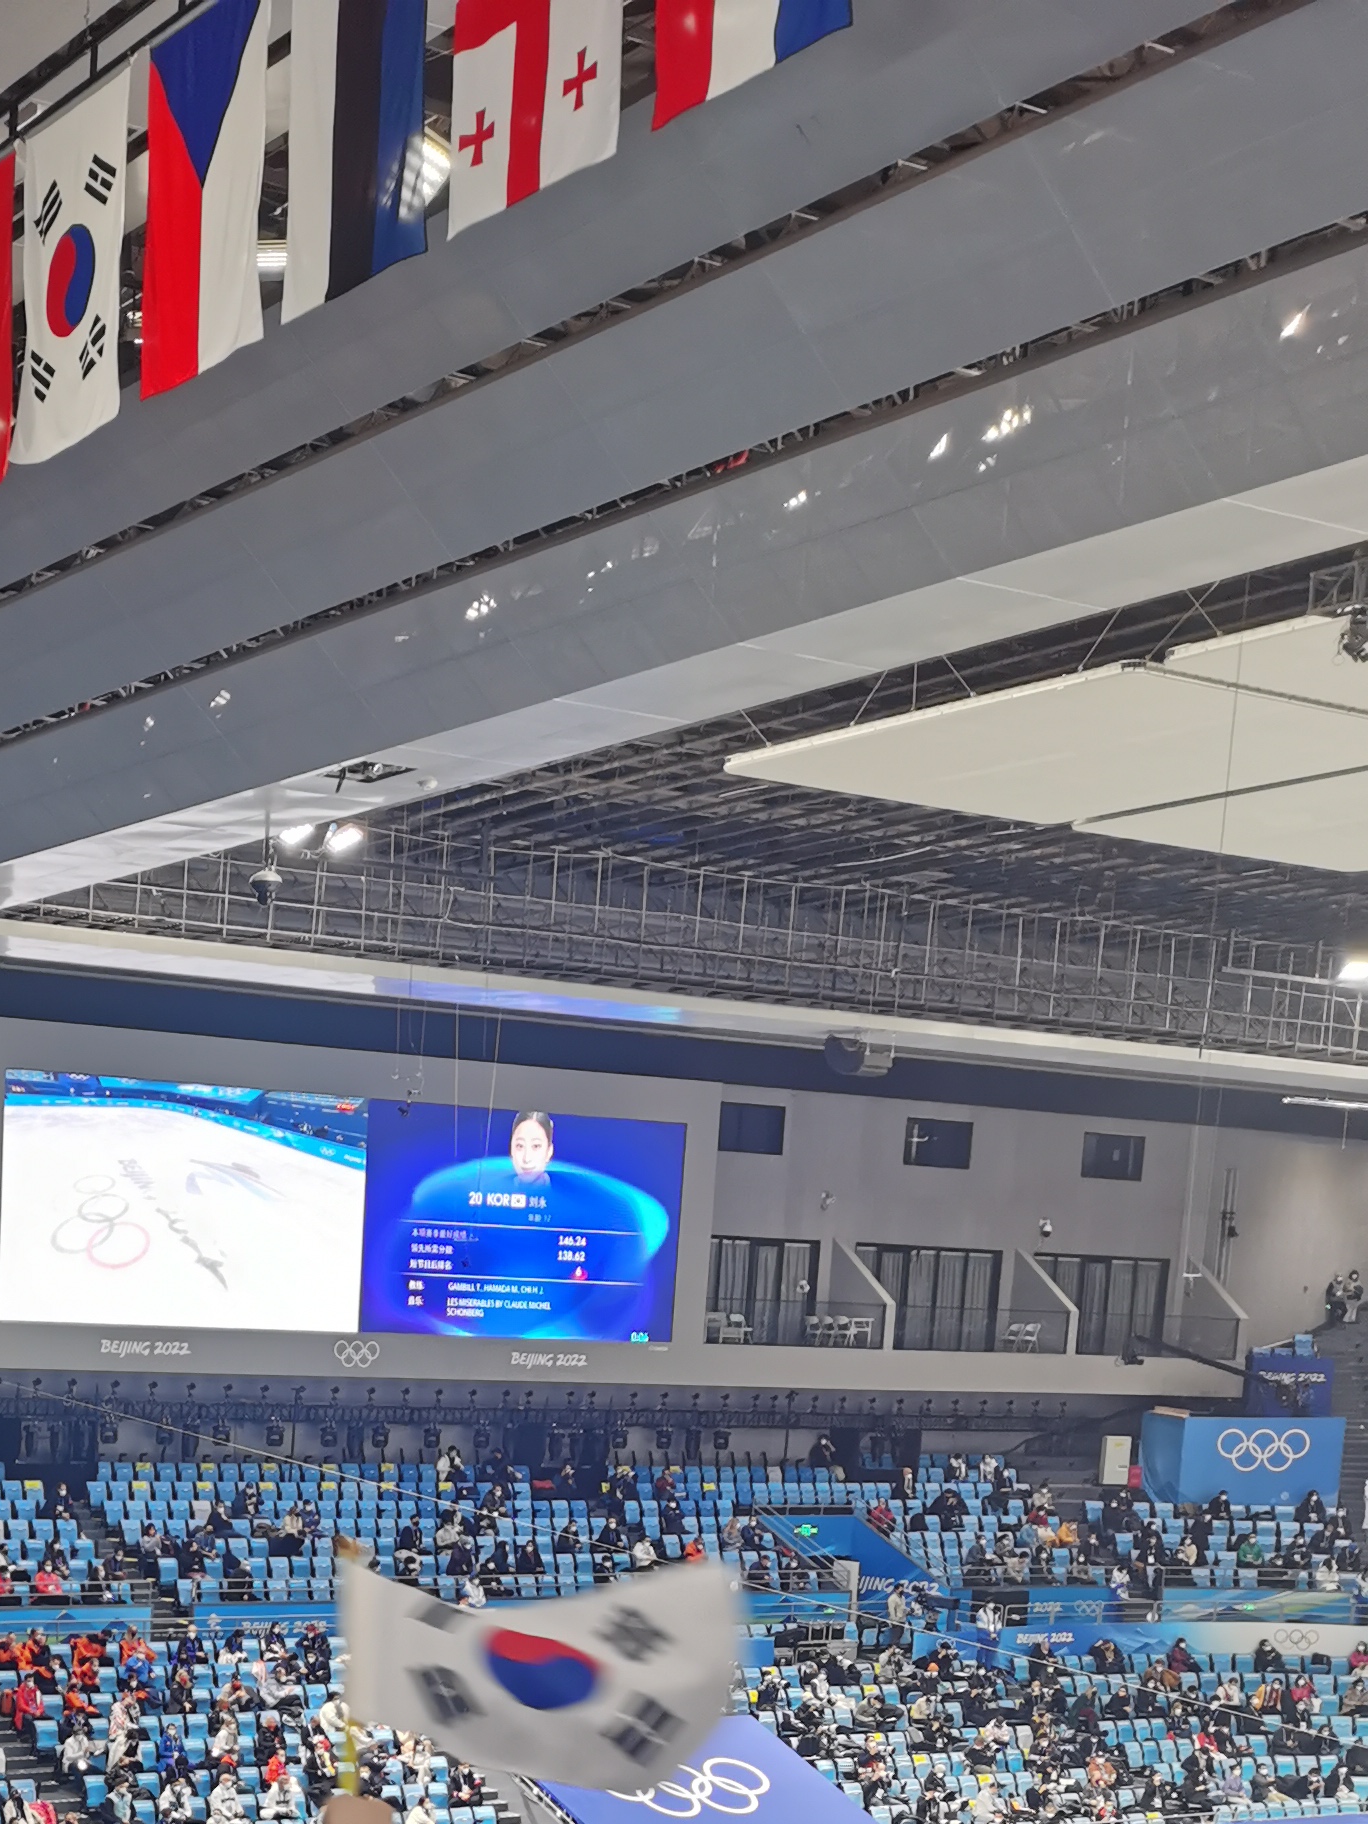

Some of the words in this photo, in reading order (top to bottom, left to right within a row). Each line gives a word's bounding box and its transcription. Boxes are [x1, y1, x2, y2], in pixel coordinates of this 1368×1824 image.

[468, 1191, 483, 1206] 20
[486, 1192, 511, 1207] KOR
[557, 1234, 587, 1247] 146.24
[100, 1338, 151, 1358] BEIJING
[153, 1341, 192, 1356] 2022
[510, 1351, 554, 1370] BEIJING
[555, 1353, 588, 1367] 2022
[1049, 1631, 1075, 1643] 2022
